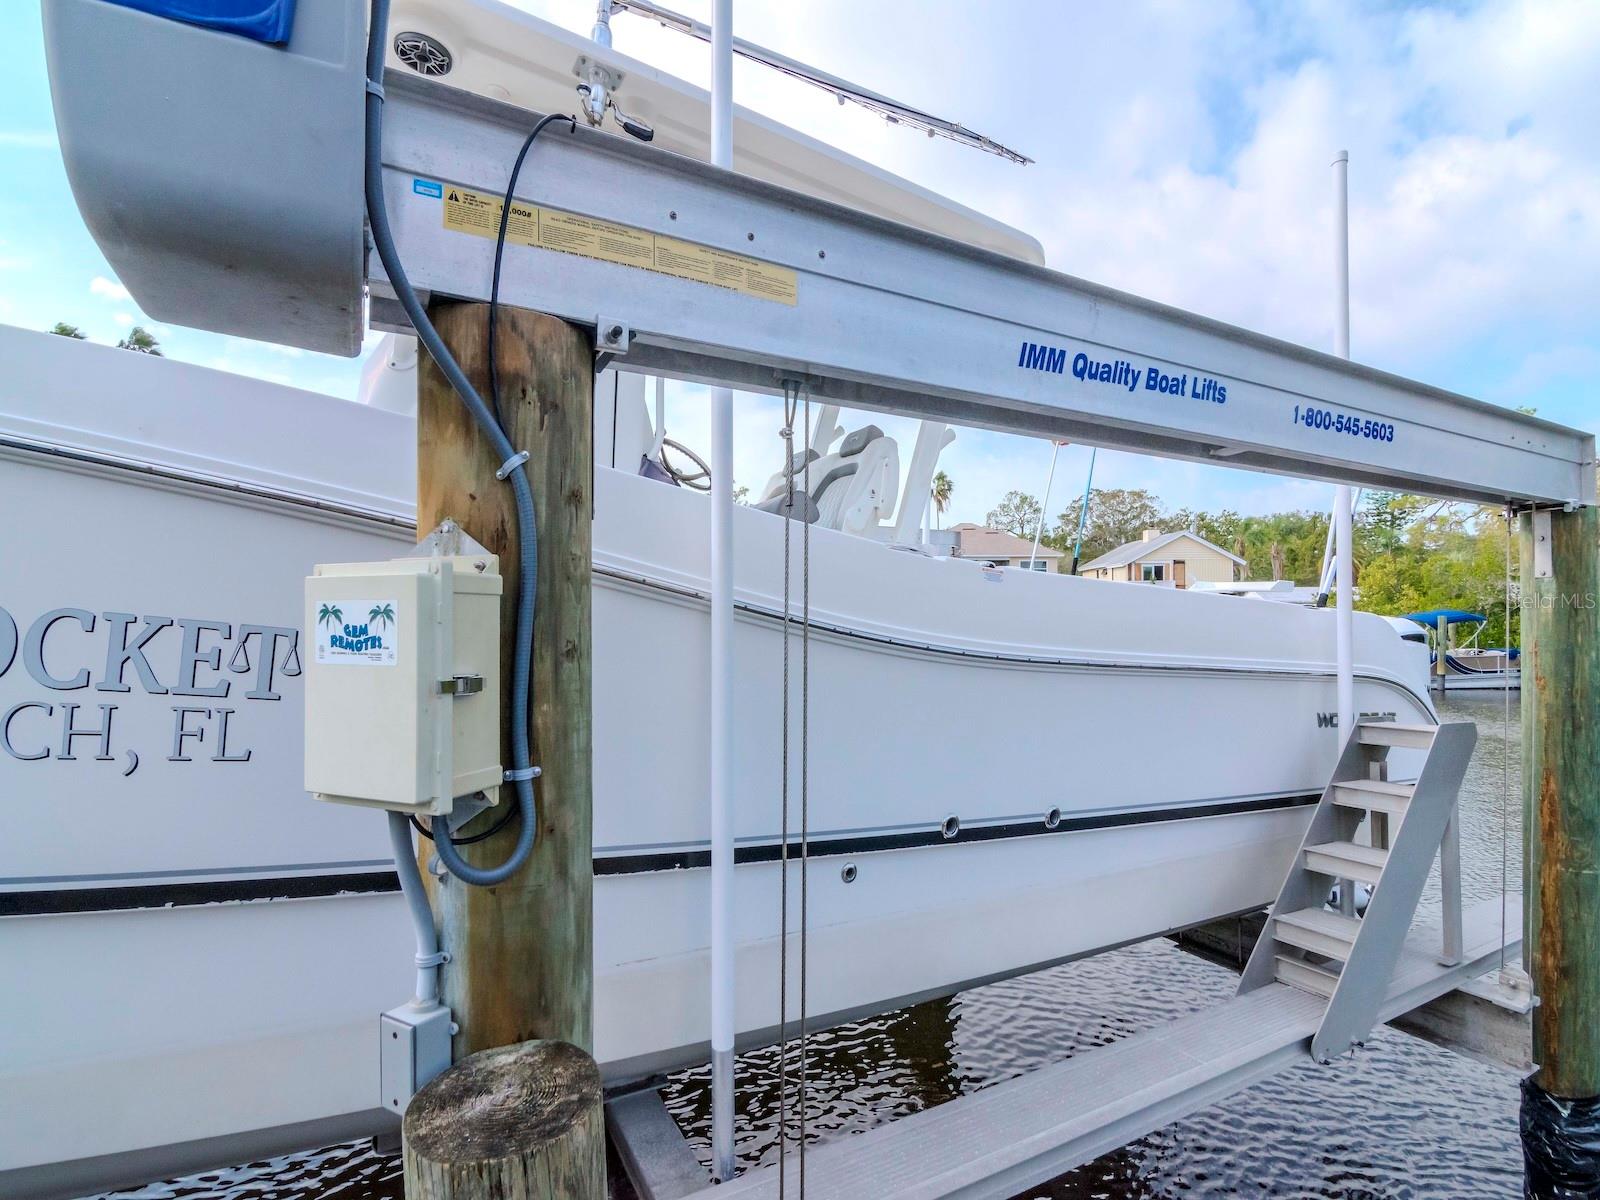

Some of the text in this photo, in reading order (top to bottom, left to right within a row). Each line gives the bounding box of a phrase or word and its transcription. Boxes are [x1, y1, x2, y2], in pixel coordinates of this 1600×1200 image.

[500, 205, 532, 218] 1,000#
[1018, 342, 1227, 404] IMM Quality Boat Lifts
[1294, 405, 1394, 442] 1-800-545-5603
[330, 634, 382, 652] REMOTES
[343, 623, 369, 638] GEM
[0, 606, 302, 700] CKET
[166, 706, 251, 761] FL
